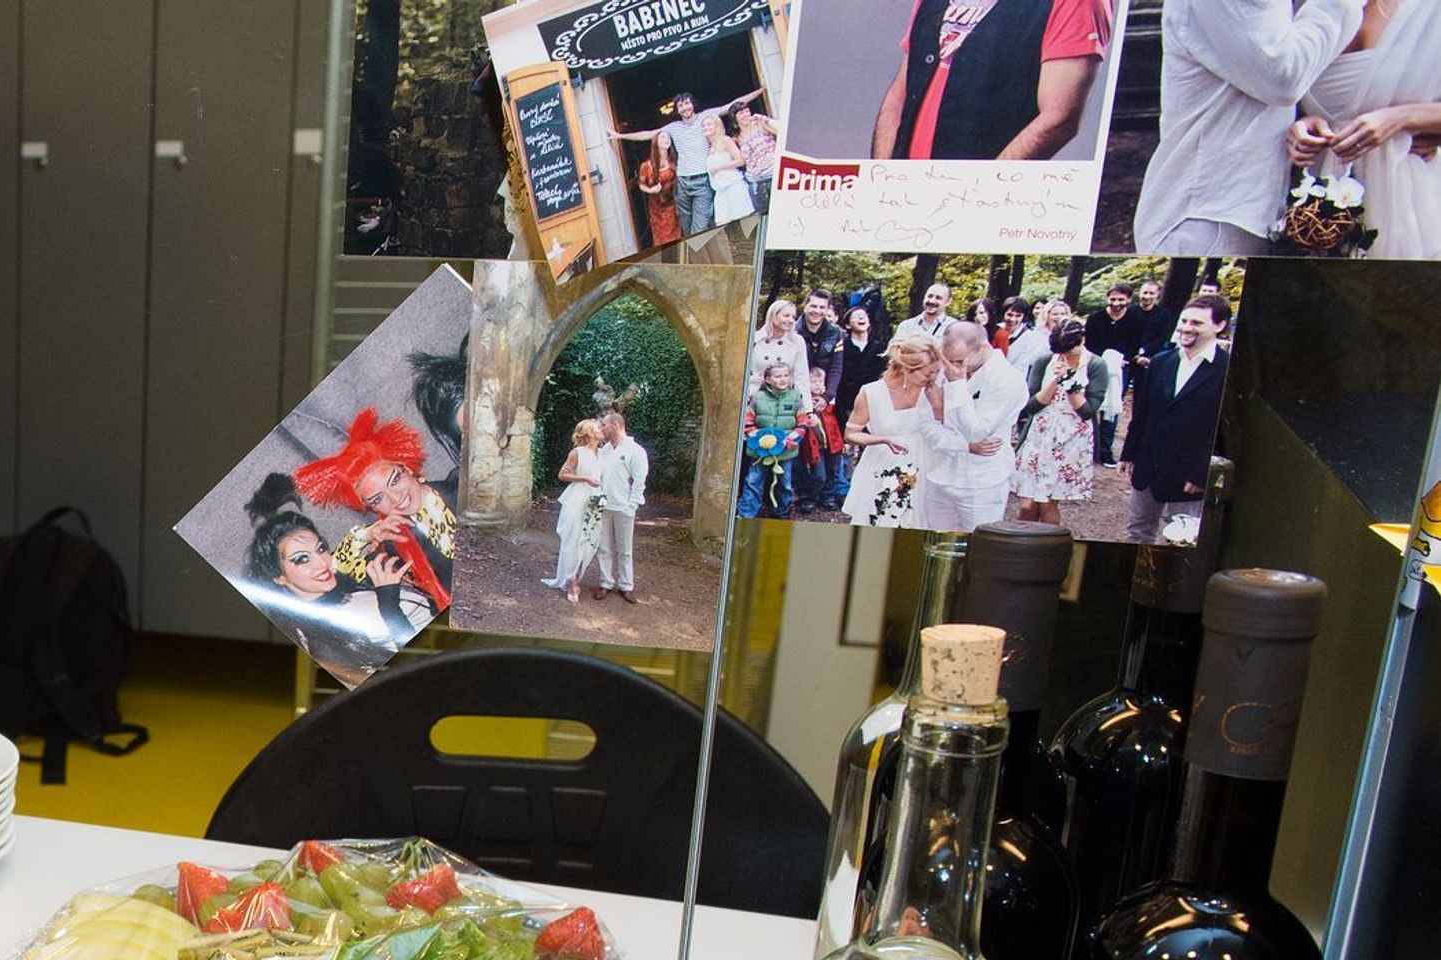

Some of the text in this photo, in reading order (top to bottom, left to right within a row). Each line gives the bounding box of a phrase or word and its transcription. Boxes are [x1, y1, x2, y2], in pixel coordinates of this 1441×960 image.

[621, 15, 710, 51] MÍSTO PRO PIVO A RUM
[782, 167, 858, 191] Prima
[996, 172, 1024, 182] co
[999, 227, 1024, 239] Petr
